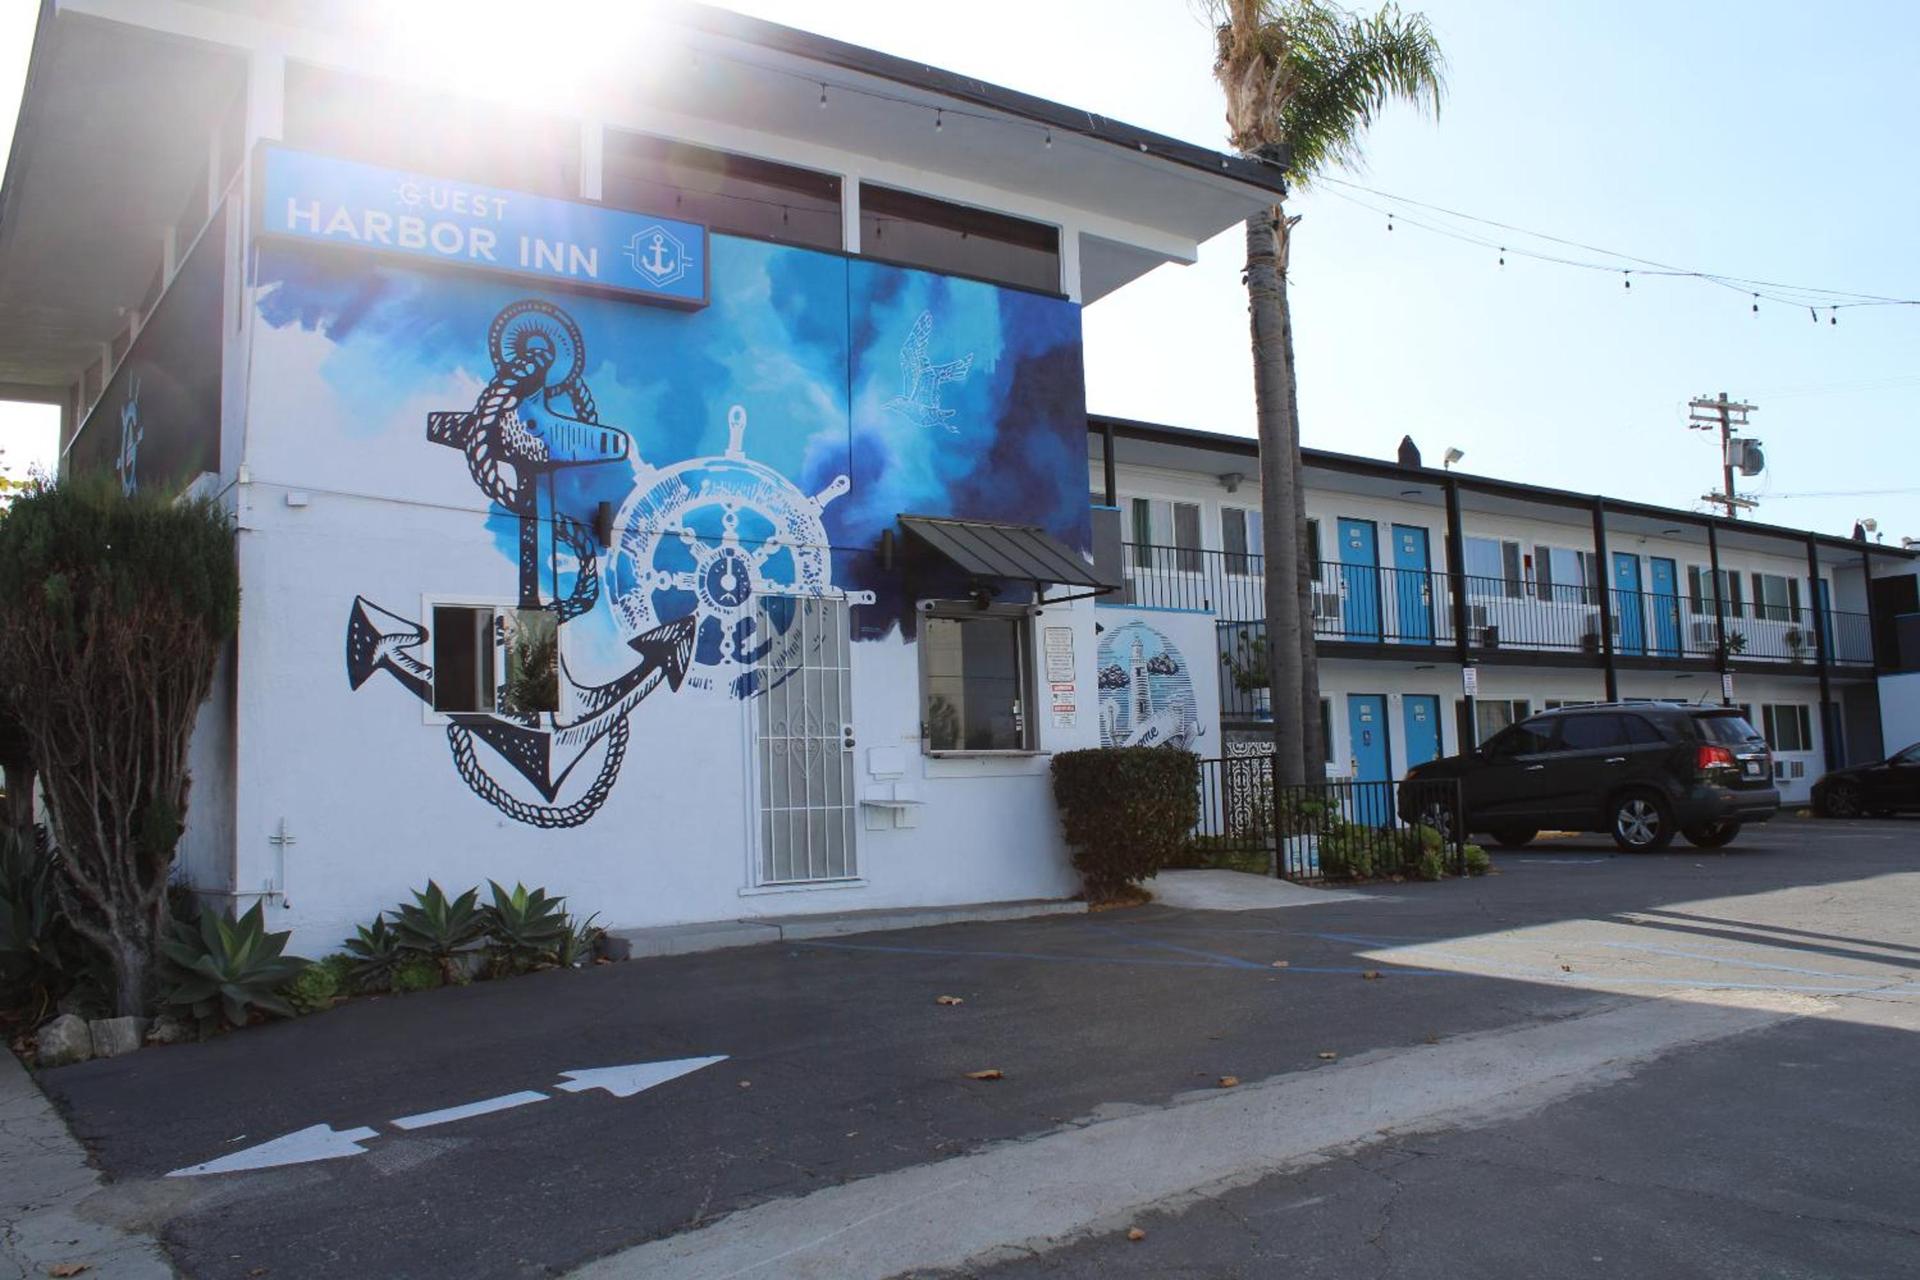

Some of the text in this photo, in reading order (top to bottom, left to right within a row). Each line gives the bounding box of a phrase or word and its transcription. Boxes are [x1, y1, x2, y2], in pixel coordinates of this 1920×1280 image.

[396, 181, 508, 221] GUEST
[287, 197, 598, 278] HARBOR INN
[1137, 726, 1159, 747] ome
